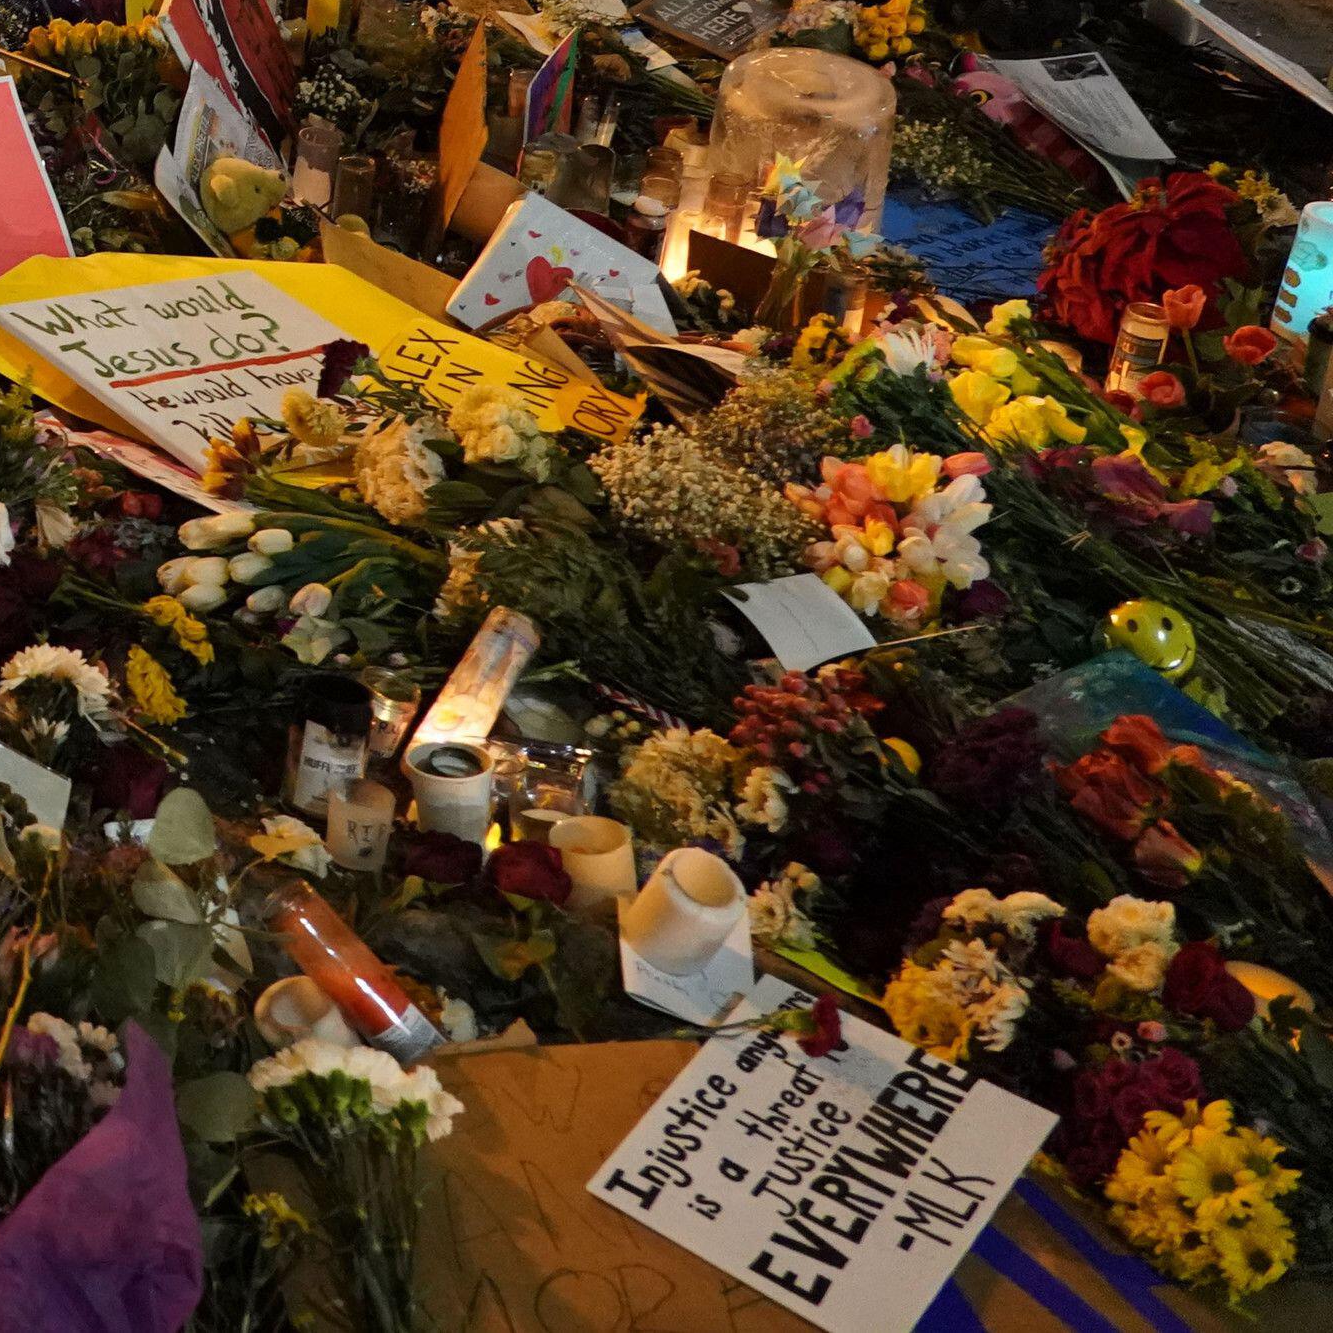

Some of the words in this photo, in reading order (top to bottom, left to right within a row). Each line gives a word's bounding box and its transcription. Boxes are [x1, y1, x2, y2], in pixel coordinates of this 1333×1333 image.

[654, 0, 690, 22] ALL
[692, 10, 745, 41] HERE
[9, 298, 138, 337] What
[144, 279, 255, 322] would
[59, 340, 202, 379] Jesus
[203, 312, 291, 360] do?
[126, 389, 172, 413] He
[173, 373, 252, 406] would
[251, 364, 323, 390] have
[603, 1072, 738, 1212] Injustice
[686, 1192, 724, 1222] is
[719, 1156, 751, 1184] a
[735, 1059, 826, 1147] threat
[747, 1045, 976, 1307] EVERYWHERE
